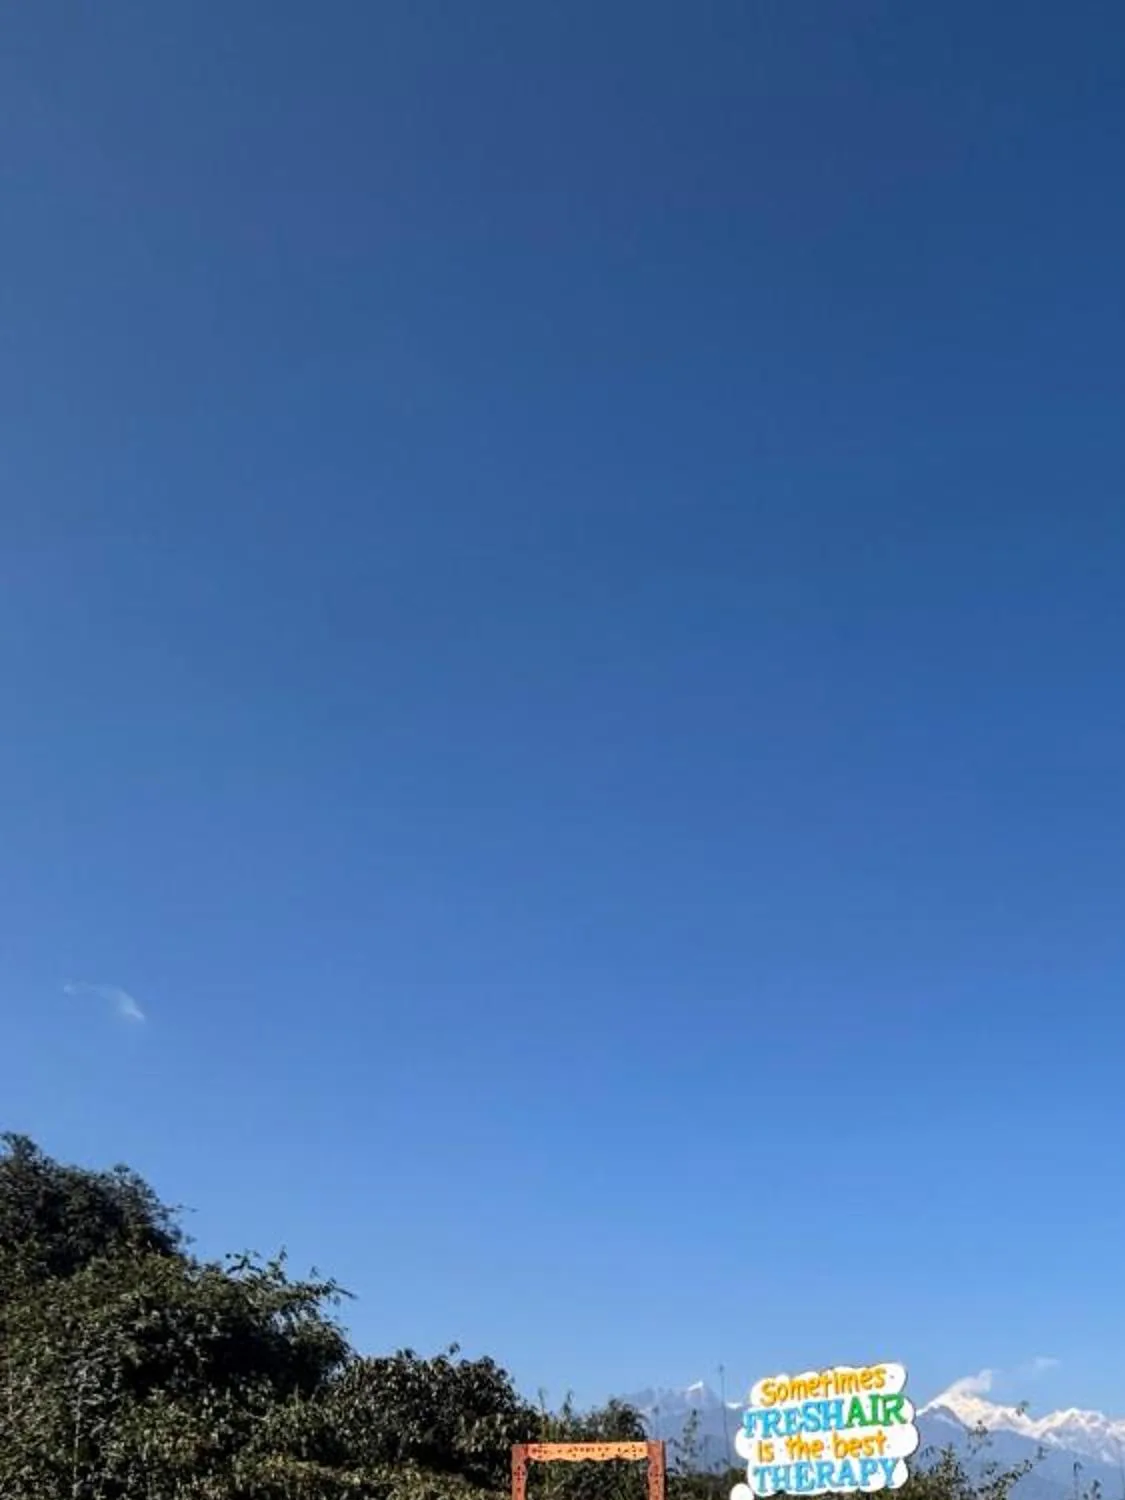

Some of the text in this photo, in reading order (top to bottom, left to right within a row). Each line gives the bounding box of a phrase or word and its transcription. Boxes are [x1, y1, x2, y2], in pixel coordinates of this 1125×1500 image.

[760, 1367, 887, 1407] Sometimes
[756, 1429, 888, 1463] is the best
[752, 1457, 898, 1492] THERAPY
